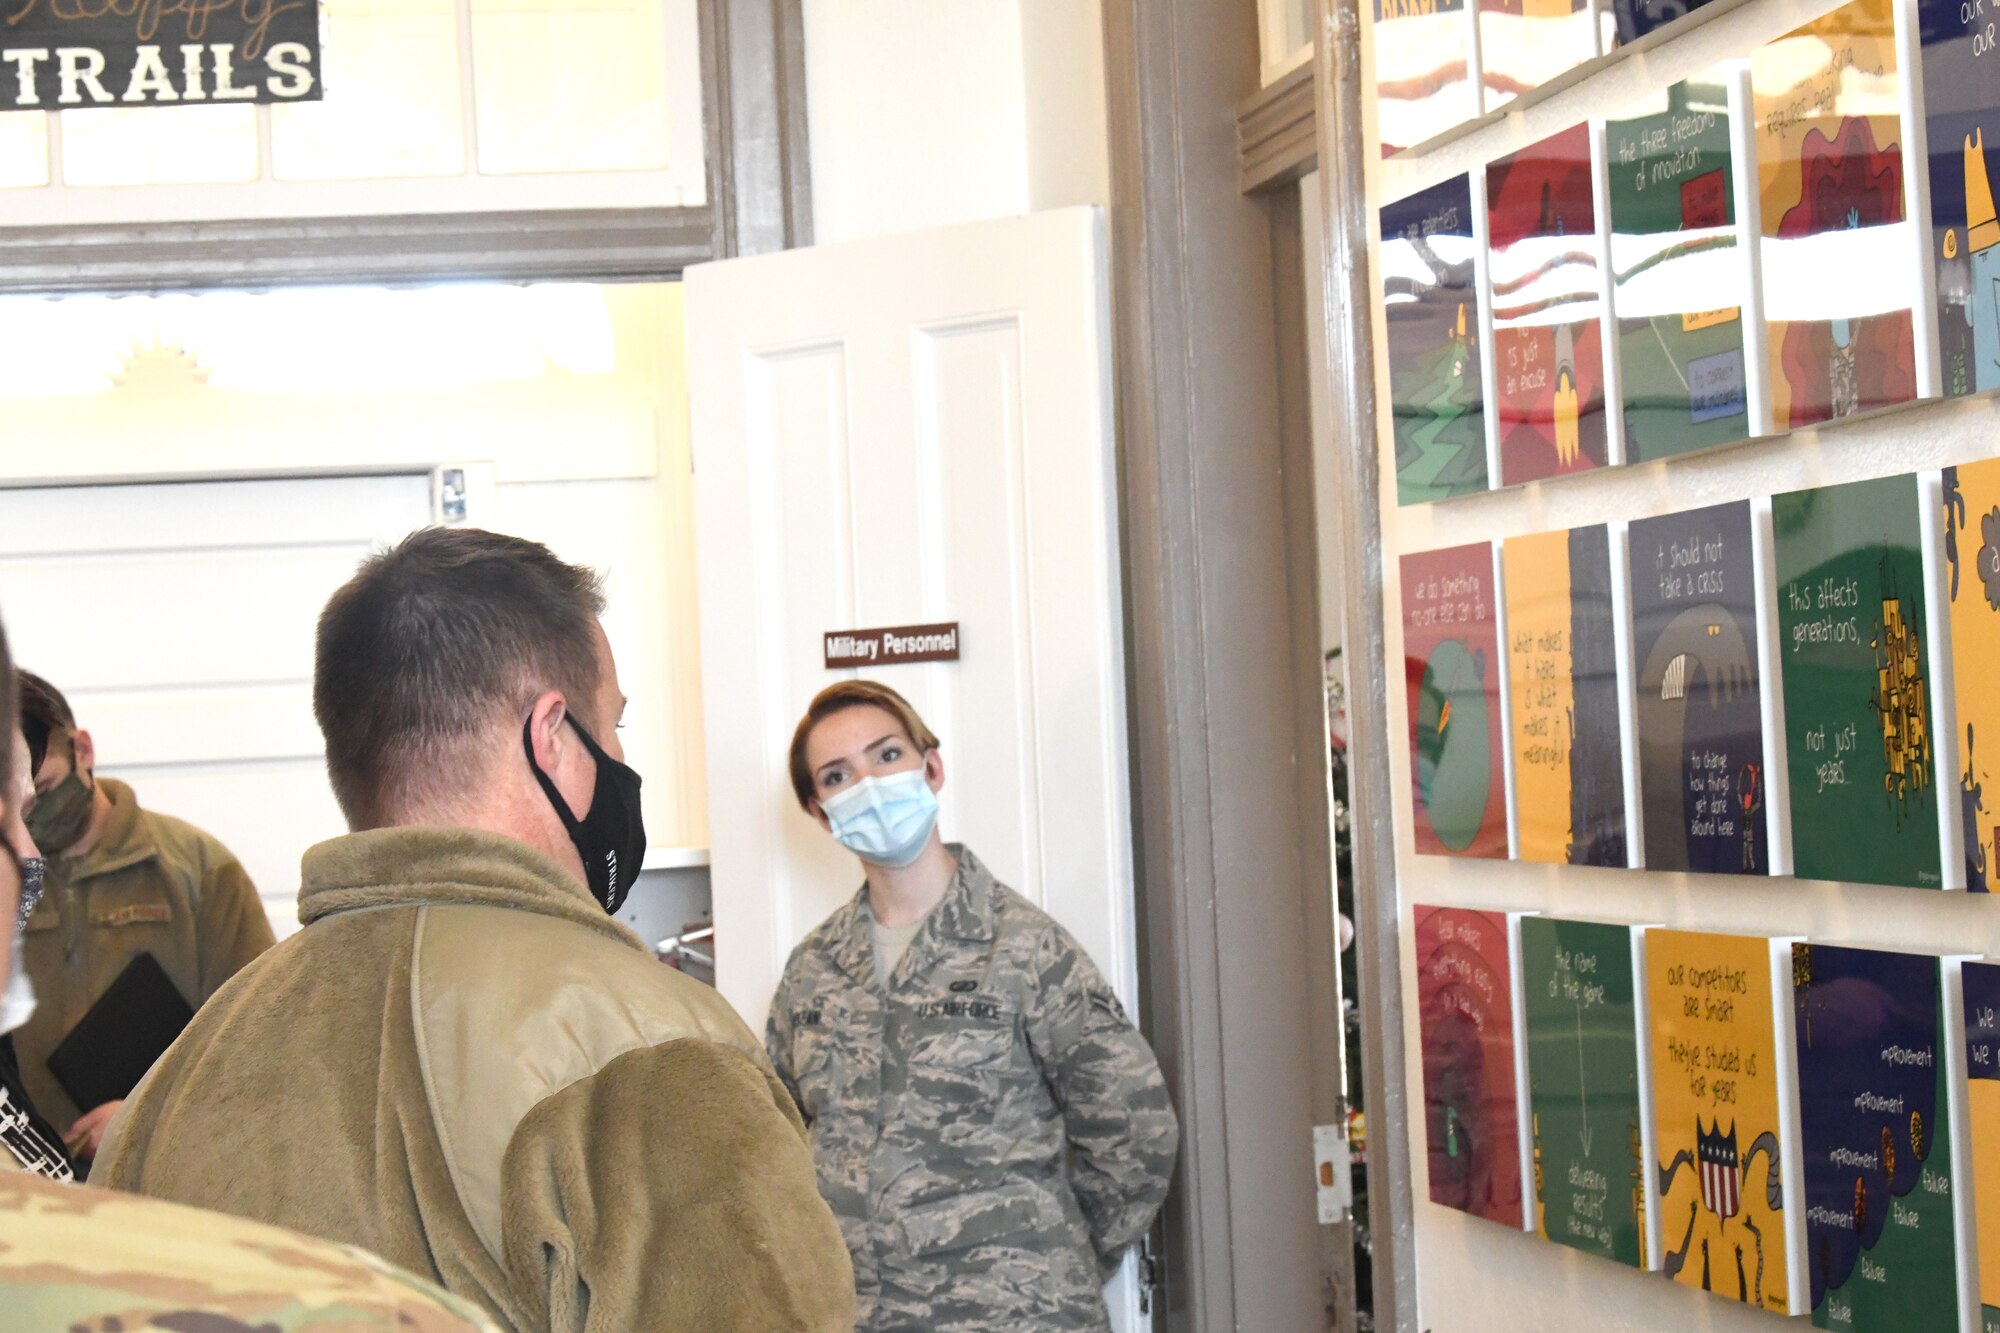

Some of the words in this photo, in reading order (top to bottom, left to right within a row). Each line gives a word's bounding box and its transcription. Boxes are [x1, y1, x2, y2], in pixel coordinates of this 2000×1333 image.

[1973, 23, 1996, 57] OUR
[2, 42, 315, 104] TRAILS
[1619, 137, 1636, 166] the
[1641, 127, 1668, 156] three
[1635, 160, 1646, 191] of
[1522, 336, 1539, 371] just
[1670, 536, 1700, 569] should
[1704, 532, 1724, 562] not
[1659, 571, 1681, 600] take
[1686, 573, 1693, 596] a
[1788, 583, 1811, 611] this
[1817, 576, 1859, 609] affects
[826, 636, 879, 660] Military
[883, 628, 956, 655] Personnel
[1806, 722, 1825, 751] not
[1834, 721, 1857, 758] just
[1692, 750, 1701, 769] to
[1703, 749, 1728, 774] change
[1689, 771, 1705, 792] how
[1707, 771, 1730, 797] things
[1695, 795, 1707, 819] get
[1710, 793, 1728, 815] done
[1717, 816, 1734, 836] here
[1554, 944, 1571, 971] the
[1574, 951, 1597, 974] name
[1548, 970, 1559, 999] of
[1562, 973, 1580, 1000] the
[1583, 980, 1604, 1009] game
[1667, 964, 1684, 986] our
[1689, 965, 1747, 995] competitors
[1683, 994, 1699, 1018] are
[1704, 995, 1734, 1023] smart
[1745, 1053, 1757, 1077] us
[1689, 1068, 1706, 1098] for
[1712, 1079, 1737, 1107] years
[1922, 1167, 1949, 1195] failure
[1893, 1201, 1920, 1230] failure
[1861, 1256, 1887, 1283] failure
[1828, 1297, 1852, 1324] failure
